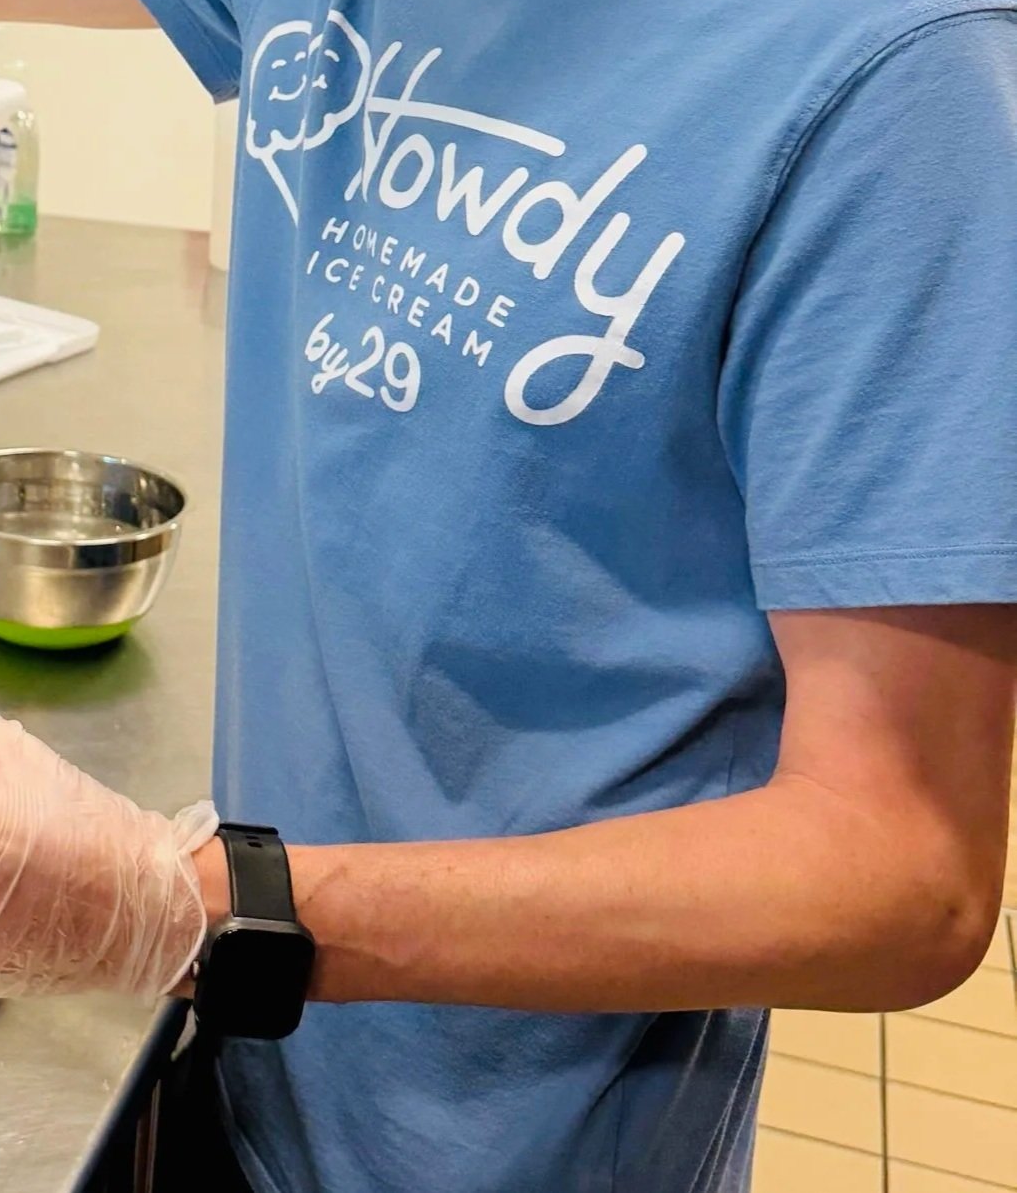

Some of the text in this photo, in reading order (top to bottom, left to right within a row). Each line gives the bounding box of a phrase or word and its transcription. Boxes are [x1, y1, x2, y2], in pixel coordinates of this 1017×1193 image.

[321, 217, 516, 318] HOMEMADE
[344, 41, 686, 426] Howdy
[304, 313, 421, 413] by 29
[306, 251, 493, 367] ICE CREAM
